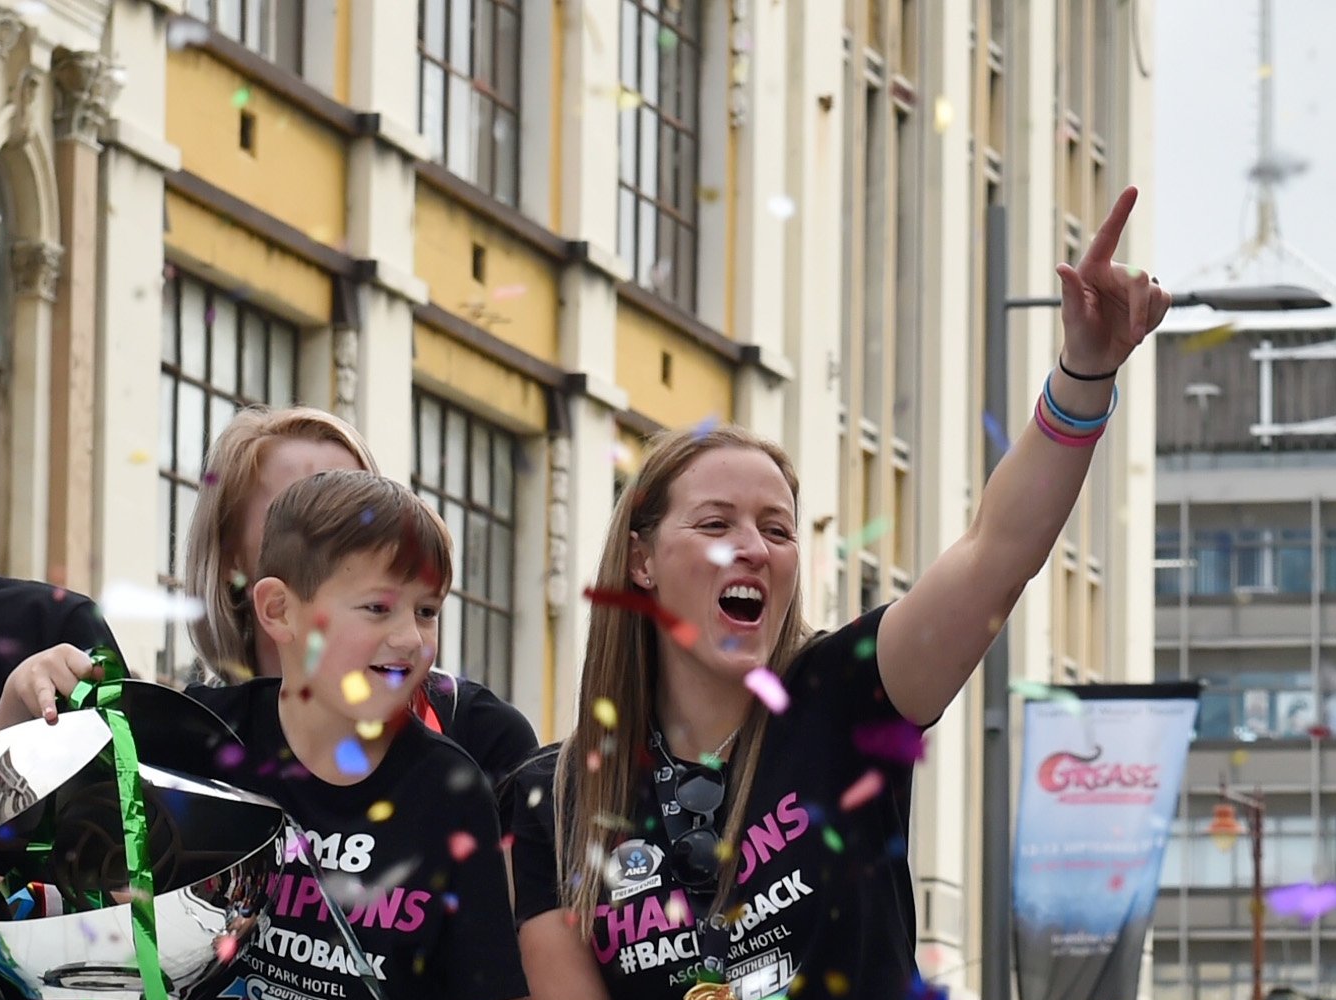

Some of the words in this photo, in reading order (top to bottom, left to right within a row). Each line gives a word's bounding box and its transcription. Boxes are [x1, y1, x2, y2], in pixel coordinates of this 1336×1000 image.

[1038, 746, 1161, 793] GREASE
[624, 865, 648, 876] ANZ
[749, 923, 792, 950] HOTEL
[725, 952, 778, 980] SOUTHERN
[267, 963, 300, 987] PARK
[302, 976, 347, 998] HOTEL
